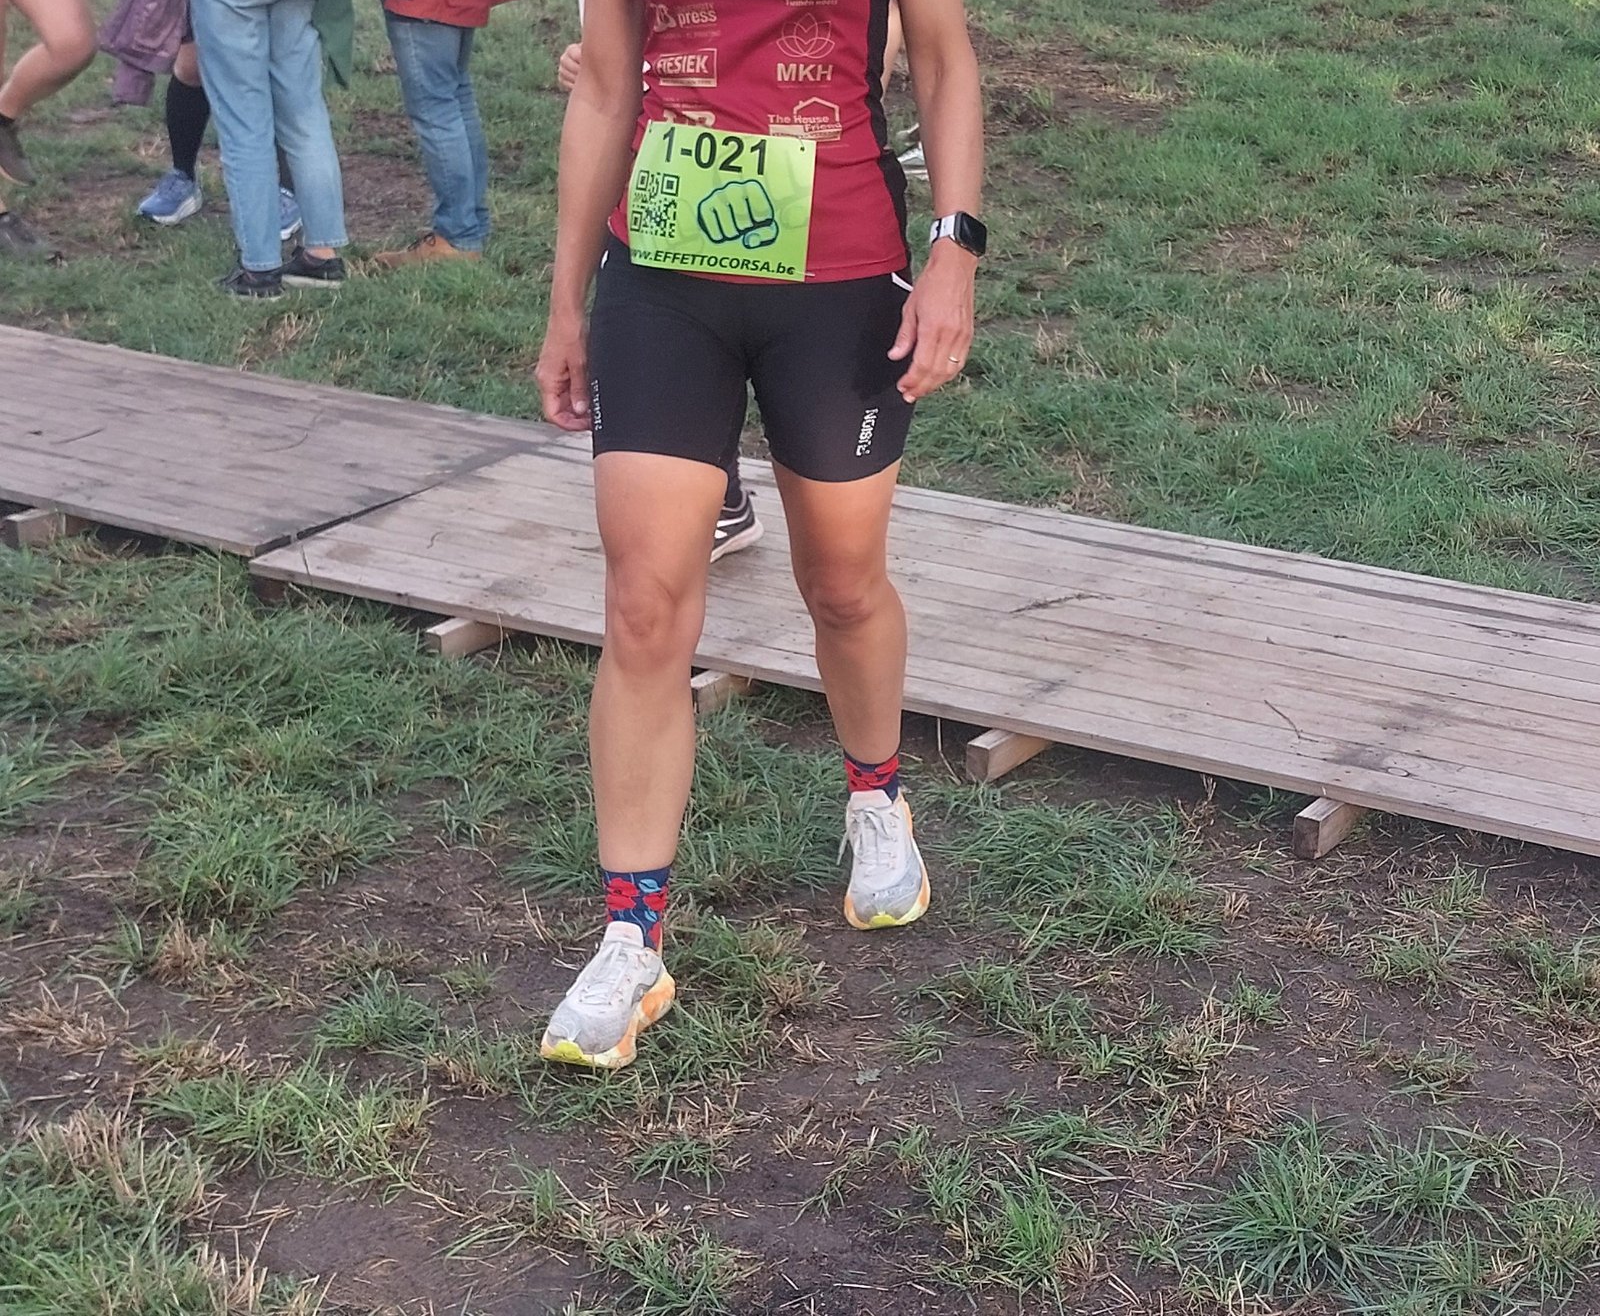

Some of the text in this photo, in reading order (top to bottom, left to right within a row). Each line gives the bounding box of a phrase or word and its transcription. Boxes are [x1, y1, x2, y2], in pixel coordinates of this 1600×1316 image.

[677, 9, 718, 29] press
[776, 63, 834, 82] MKH
[767, 113, 792, 124] The
[662, 126, 768, 176] 1-021
